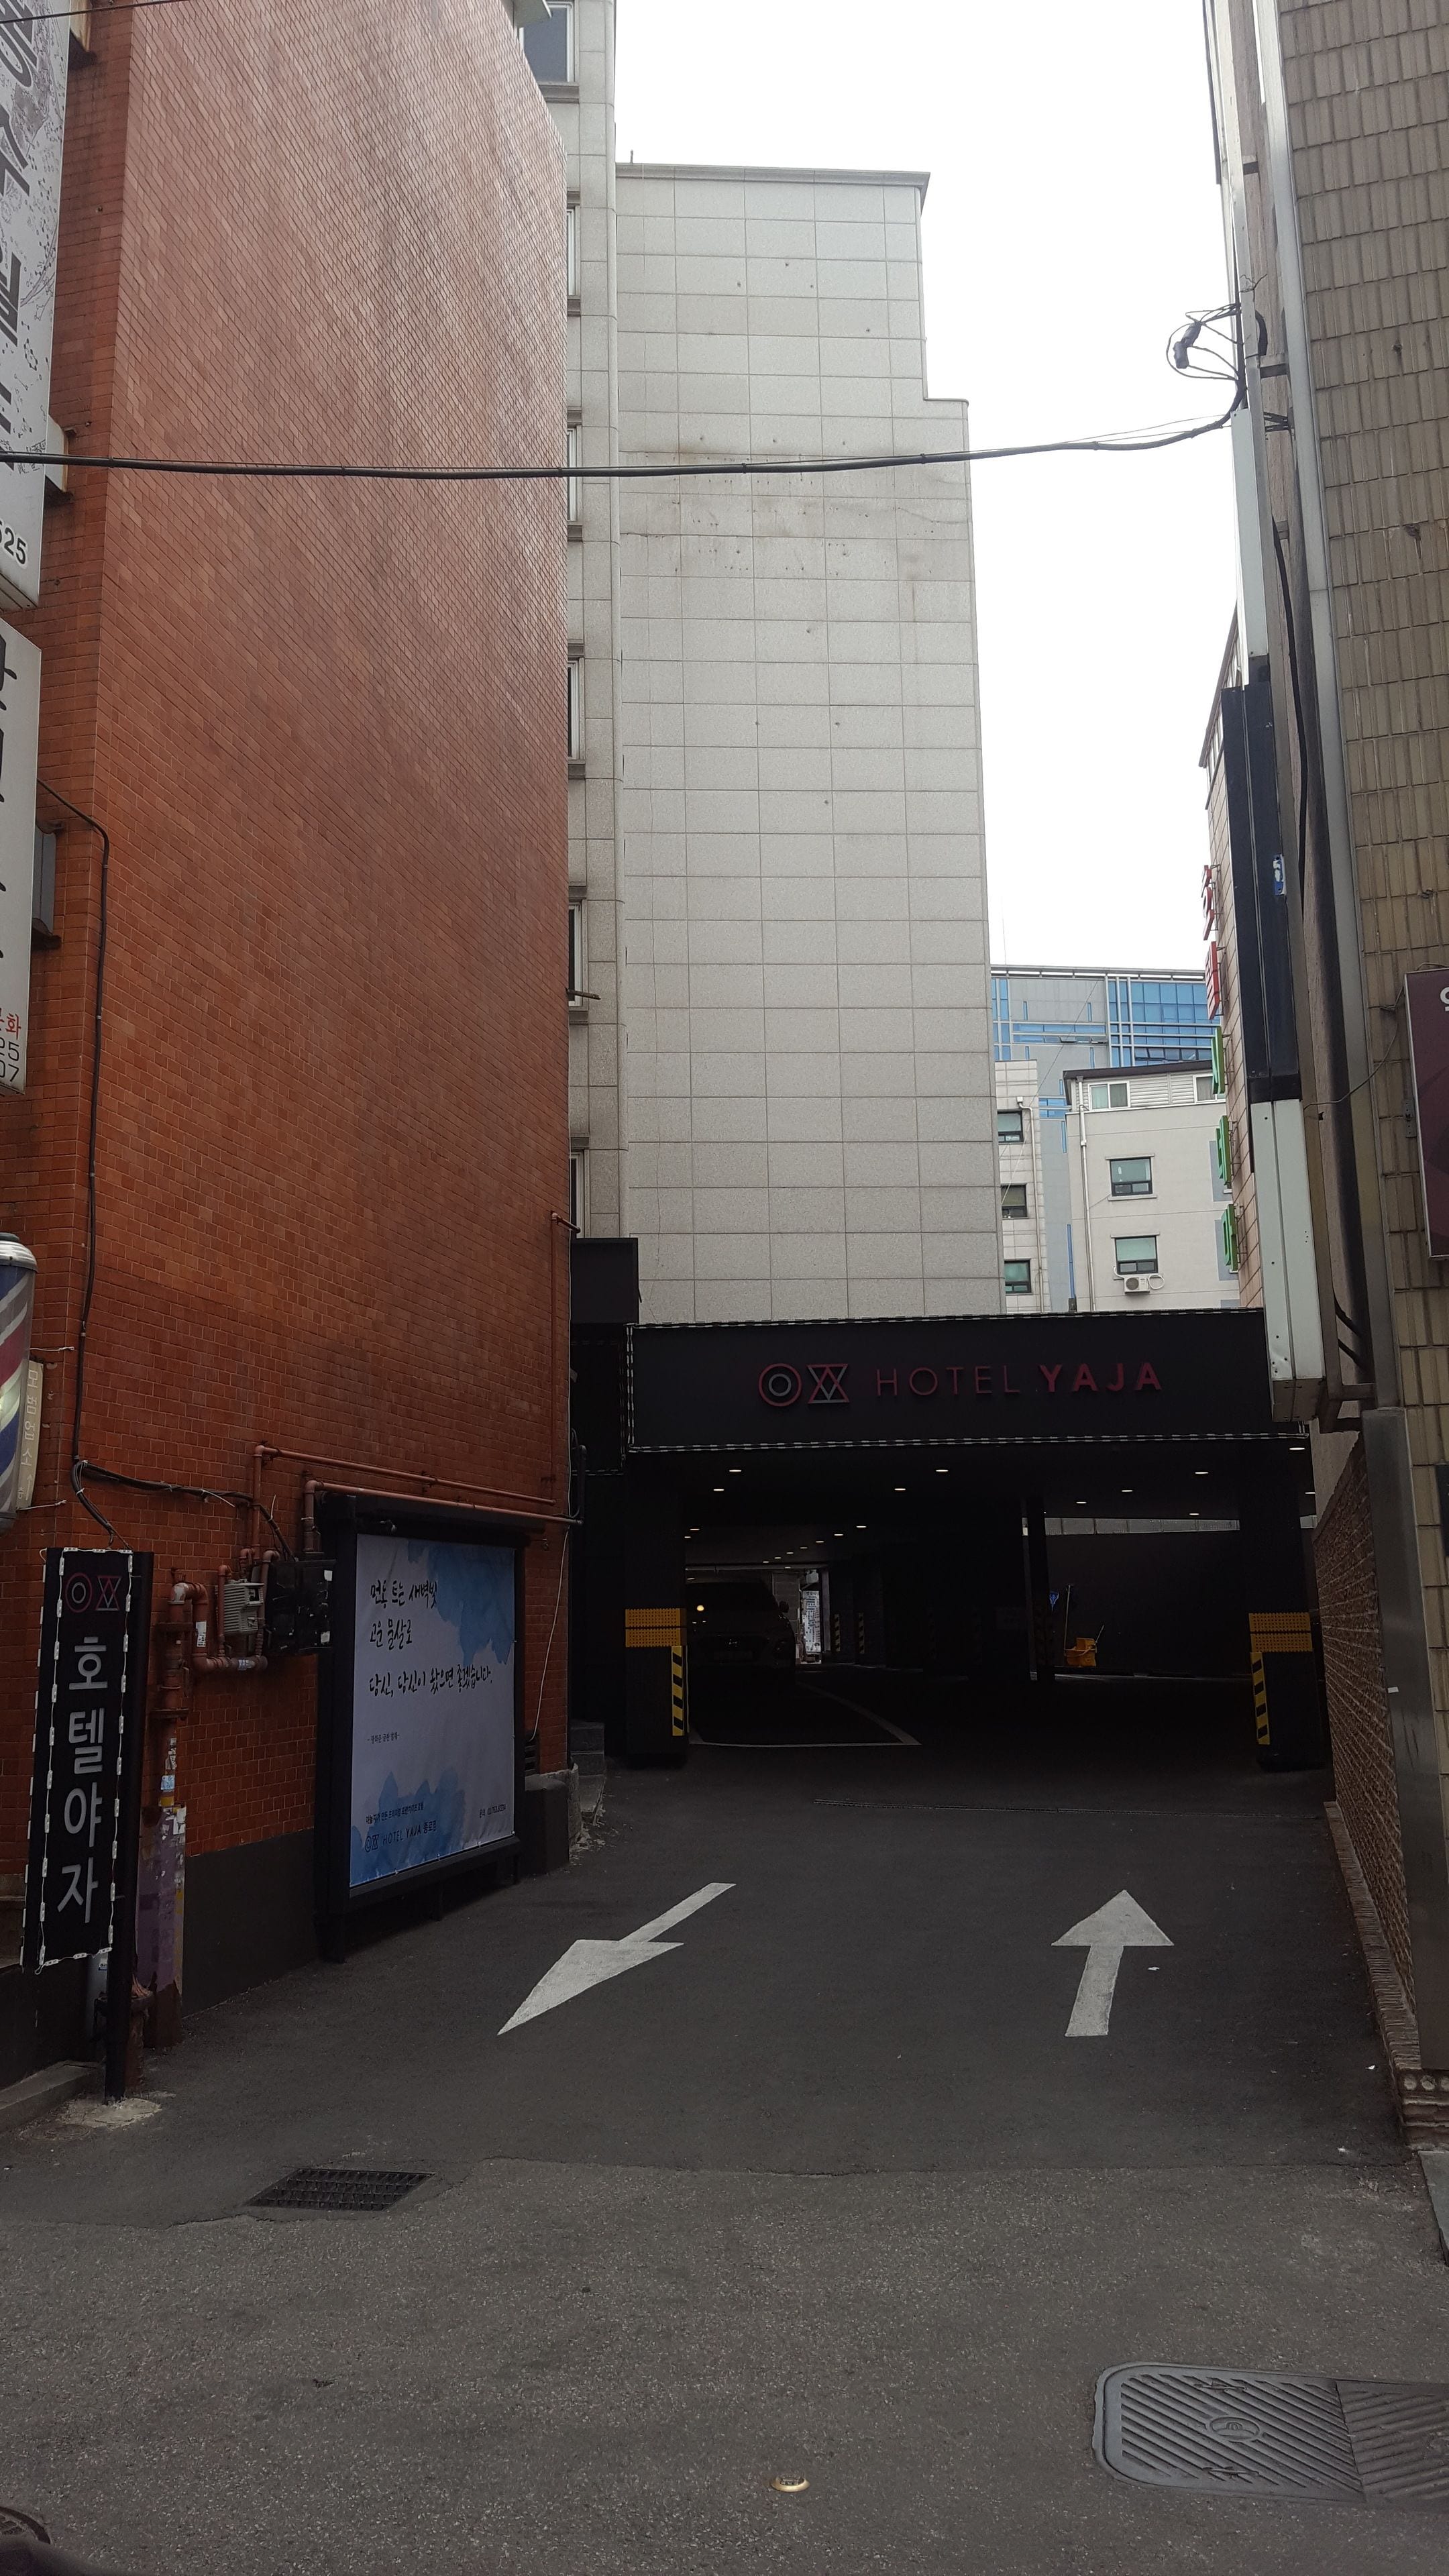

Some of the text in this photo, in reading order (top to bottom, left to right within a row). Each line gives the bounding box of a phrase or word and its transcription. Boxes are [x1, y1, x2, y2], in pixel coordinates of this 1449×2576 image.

[0, 521, 26, 565] 25
[876, 1362, 1162, 1397] HOTEL YAJA
[370, 1579, 437, 1609] 먼동 트는 새벽빛
[370, 1618, 413, 1650] 고운 물살로
[369, 1664, 492, 1697] 당신, 당신이 왔으면 좋겠습니다.
[383, 1829, 403, 1845] HOTEL
[406, 1824, 421, 1839] YAJA
